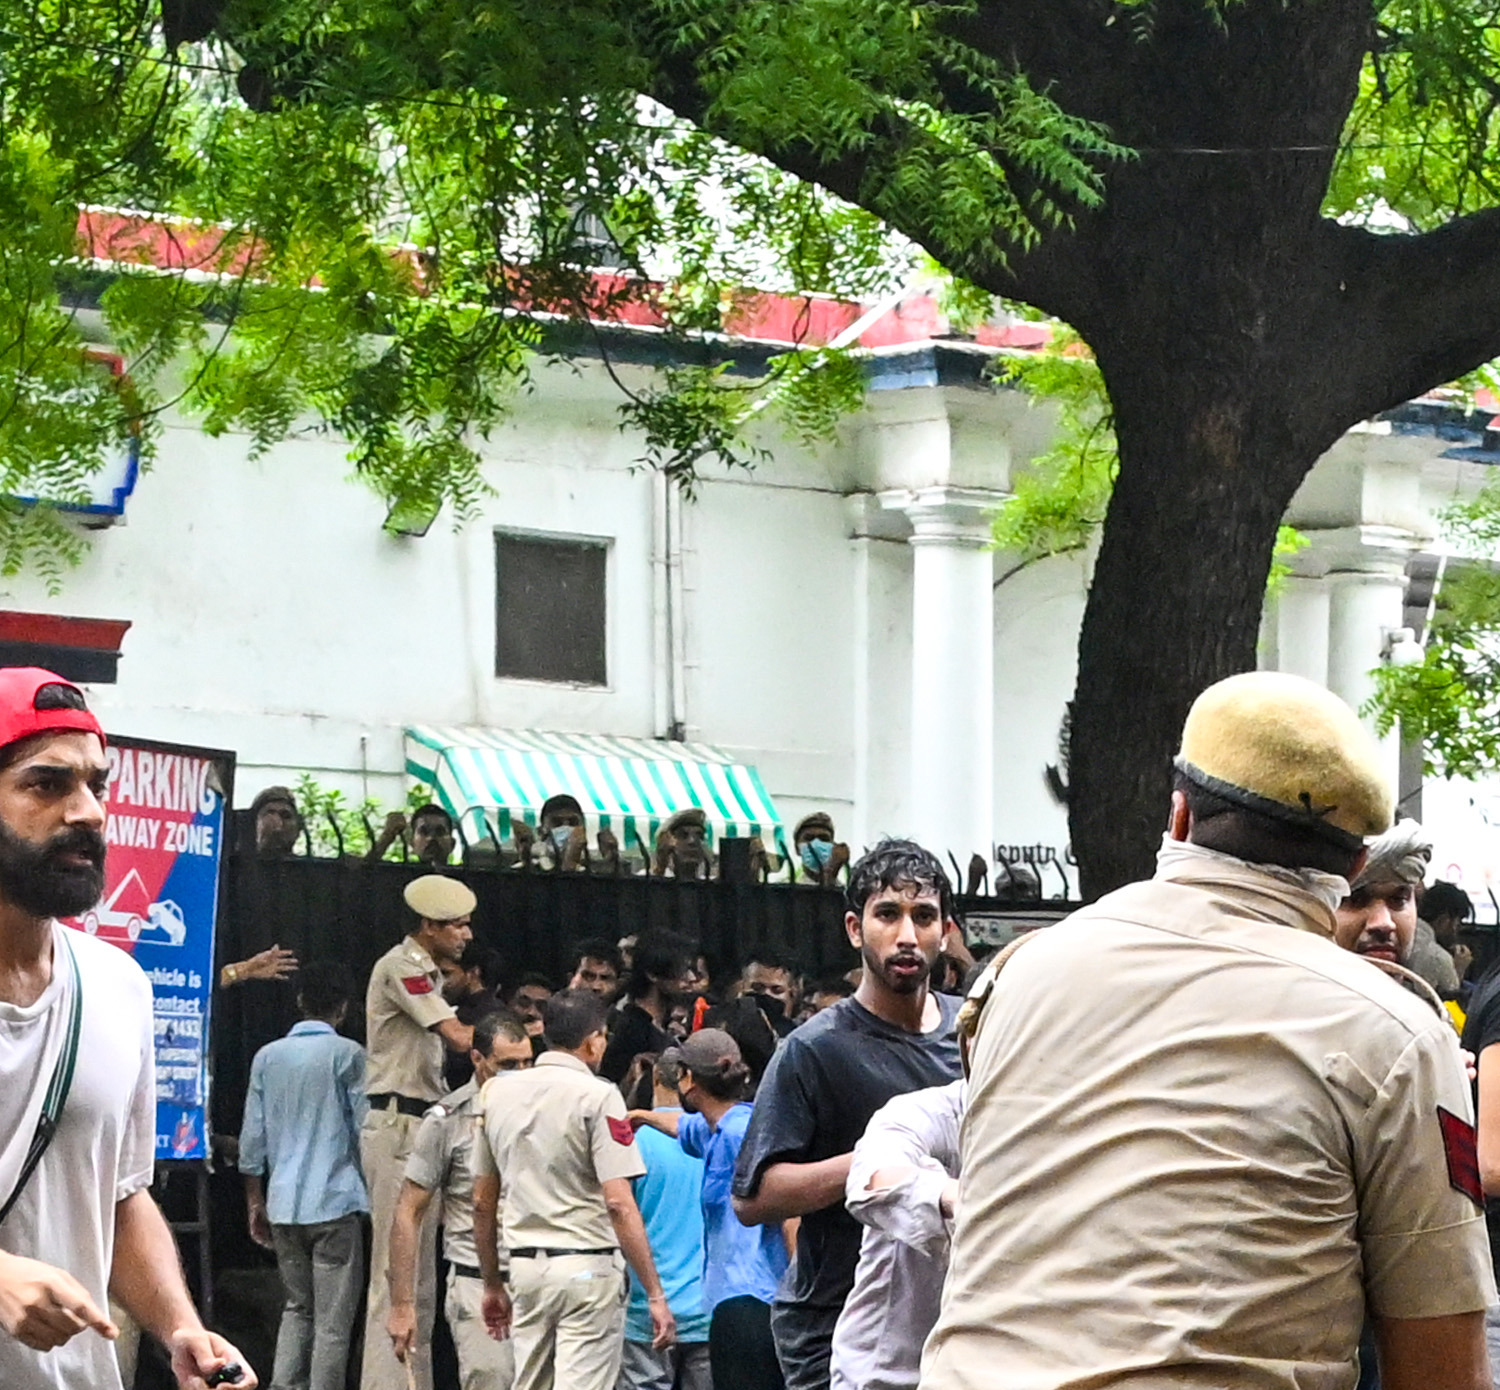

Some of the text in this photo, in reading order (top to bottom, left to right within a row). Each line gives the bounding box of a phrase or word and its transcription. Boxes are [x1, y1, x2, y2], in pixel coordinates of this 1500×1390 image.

[104, 746, 216, 816] PARKING
[105, 814, 215, 857] AWAY ZONE
[188, 970, 202, 989] is
